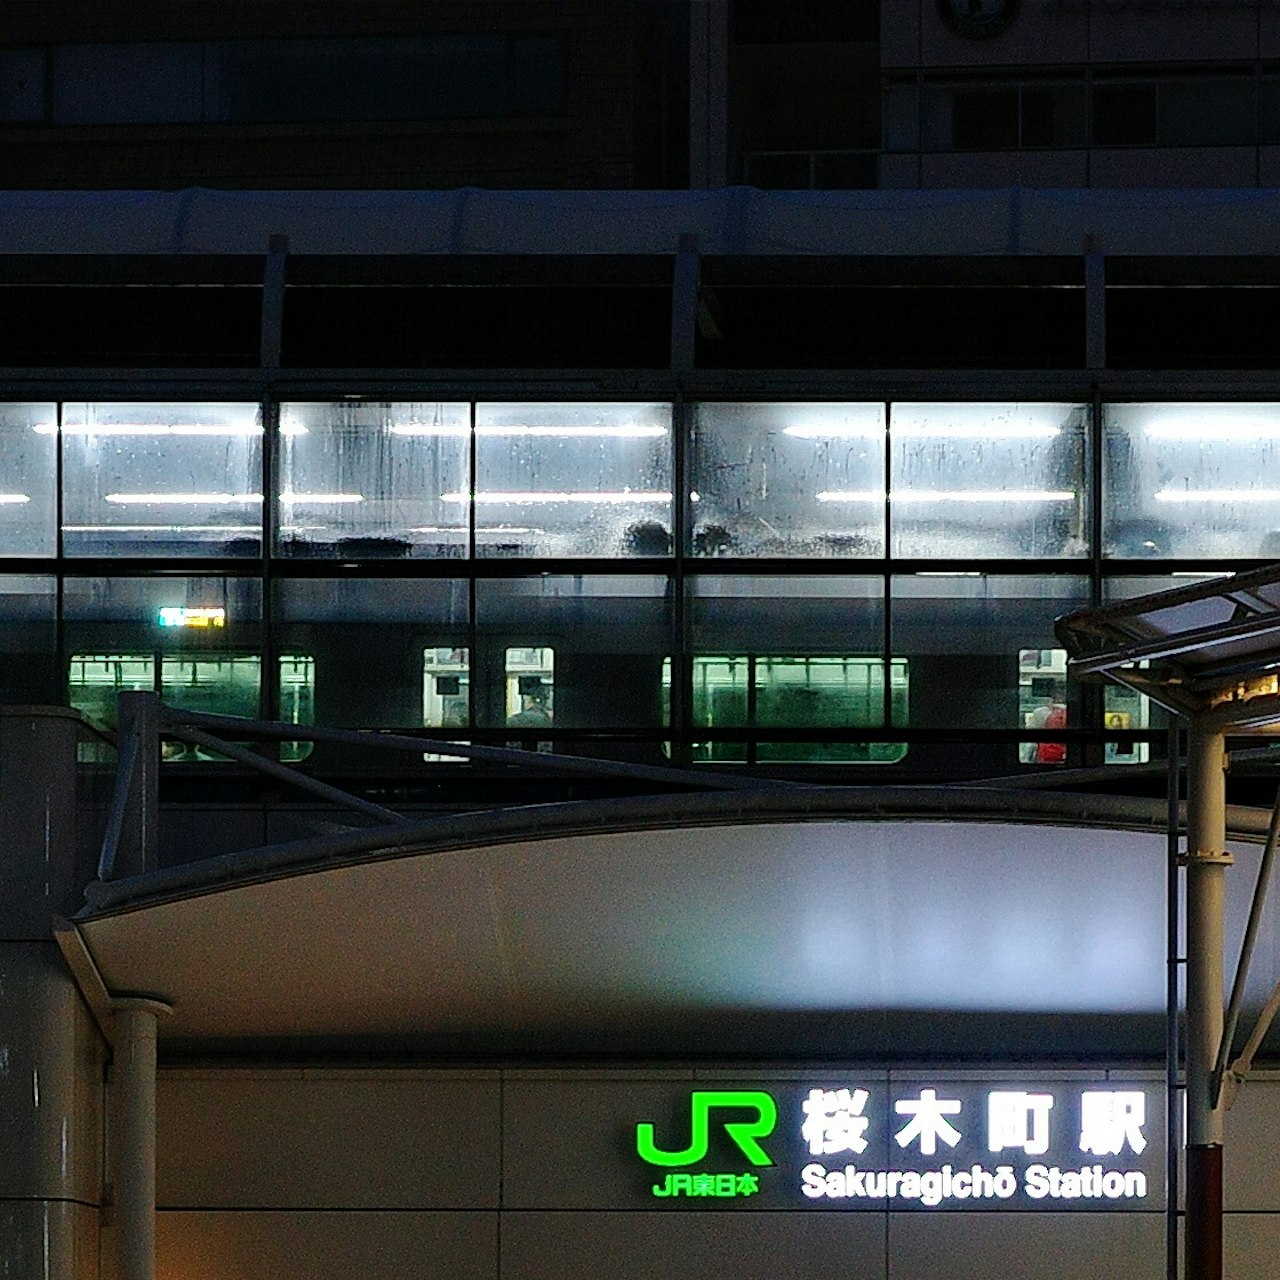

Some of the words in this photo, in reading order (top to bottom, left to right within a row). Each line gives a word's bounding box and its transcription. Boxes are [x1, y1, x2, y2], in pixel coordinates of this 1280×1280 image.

[636, 1091, 777, 1167] JR
[801, 1088, 1147, 1155] 桜木町駅
[652, 1173, 759, 1197] JR東日本
[801, 1164, 1017, 1206] Sakuragichō
[1024, 1164, 1147, 1199] Station
